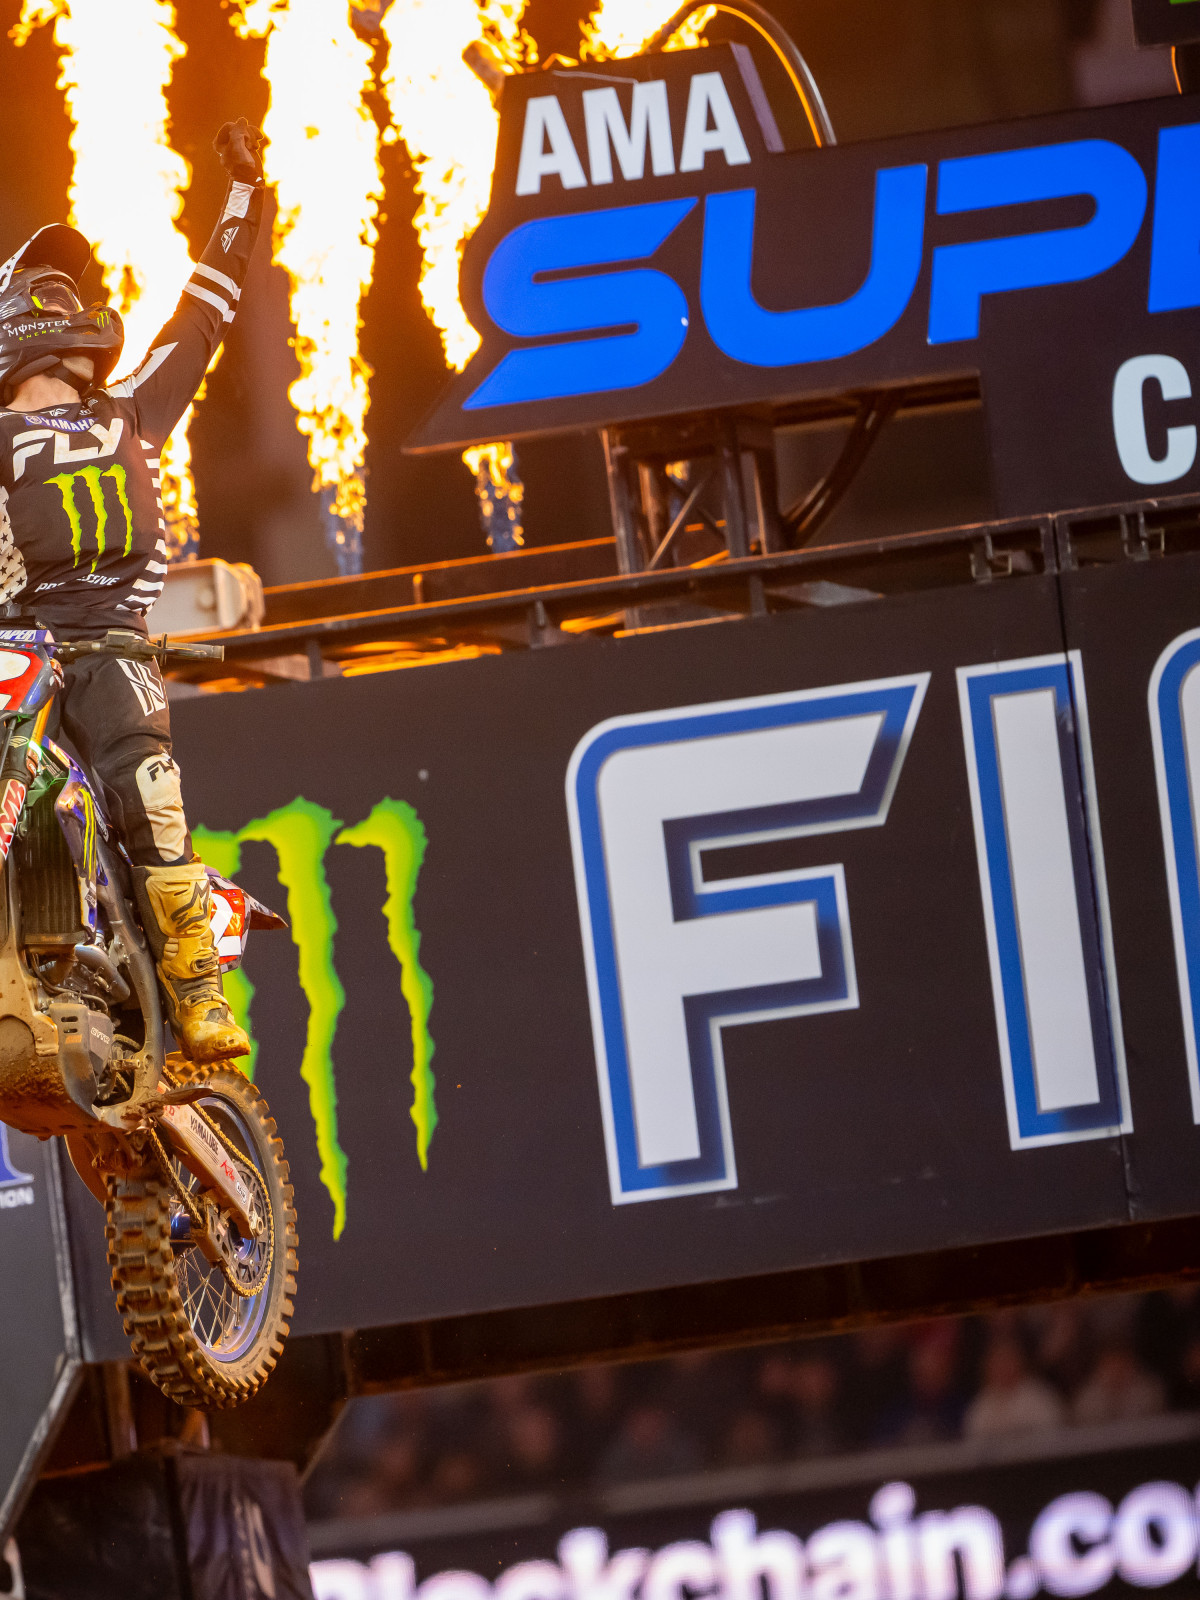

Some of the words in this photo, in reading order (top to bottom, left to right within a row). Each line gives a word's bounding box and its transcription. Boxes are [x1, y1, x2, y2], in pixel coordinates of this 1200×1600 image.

[516, 71, 751, 196] AMA
[8, 319, 71, 337] MONSTER
[19, 328, 62, 341] ENERGY
[12, 418, 124, 482] FLY
[565, 626, 1200, 1205] FI
[190, 1115, 219, 1156] YAMALUBE
